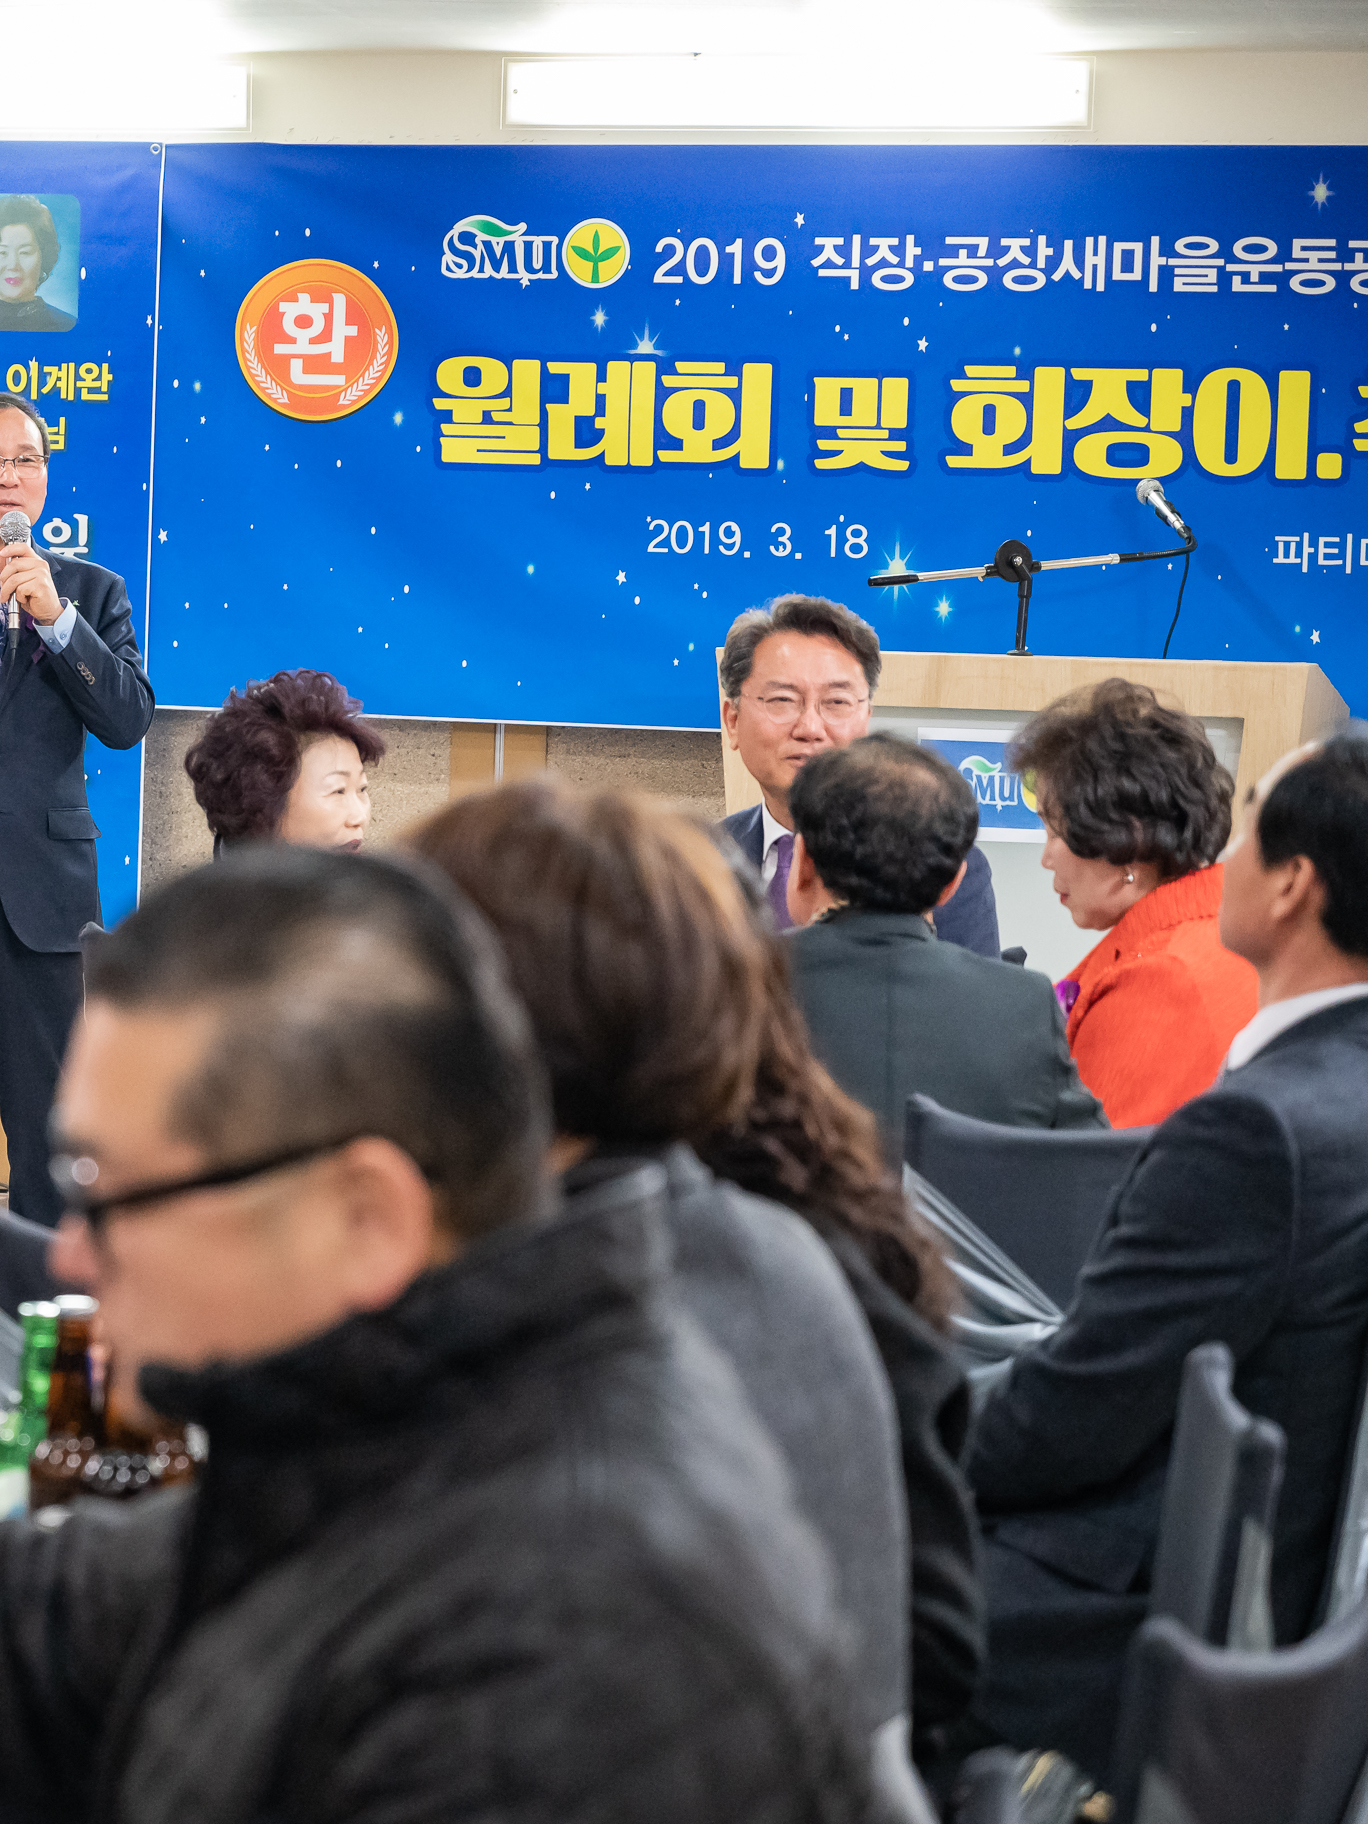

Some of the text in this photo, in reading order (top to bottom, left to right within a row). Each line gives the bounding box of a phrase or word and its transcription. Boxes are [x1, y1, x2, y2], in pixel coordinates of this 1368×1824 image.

[441, 222, 559, 280] SMU
[653, 236, 787, 286] 2019
[273, 292, 359, 386] 환
[5, 361, 113, 402] 이계완
[432, 355, 1368, 480] 월례회 및 회장이.
[647, 519, 869, 560] 2019. 3. 18
[1272, 532, 1368, 575] 파티
